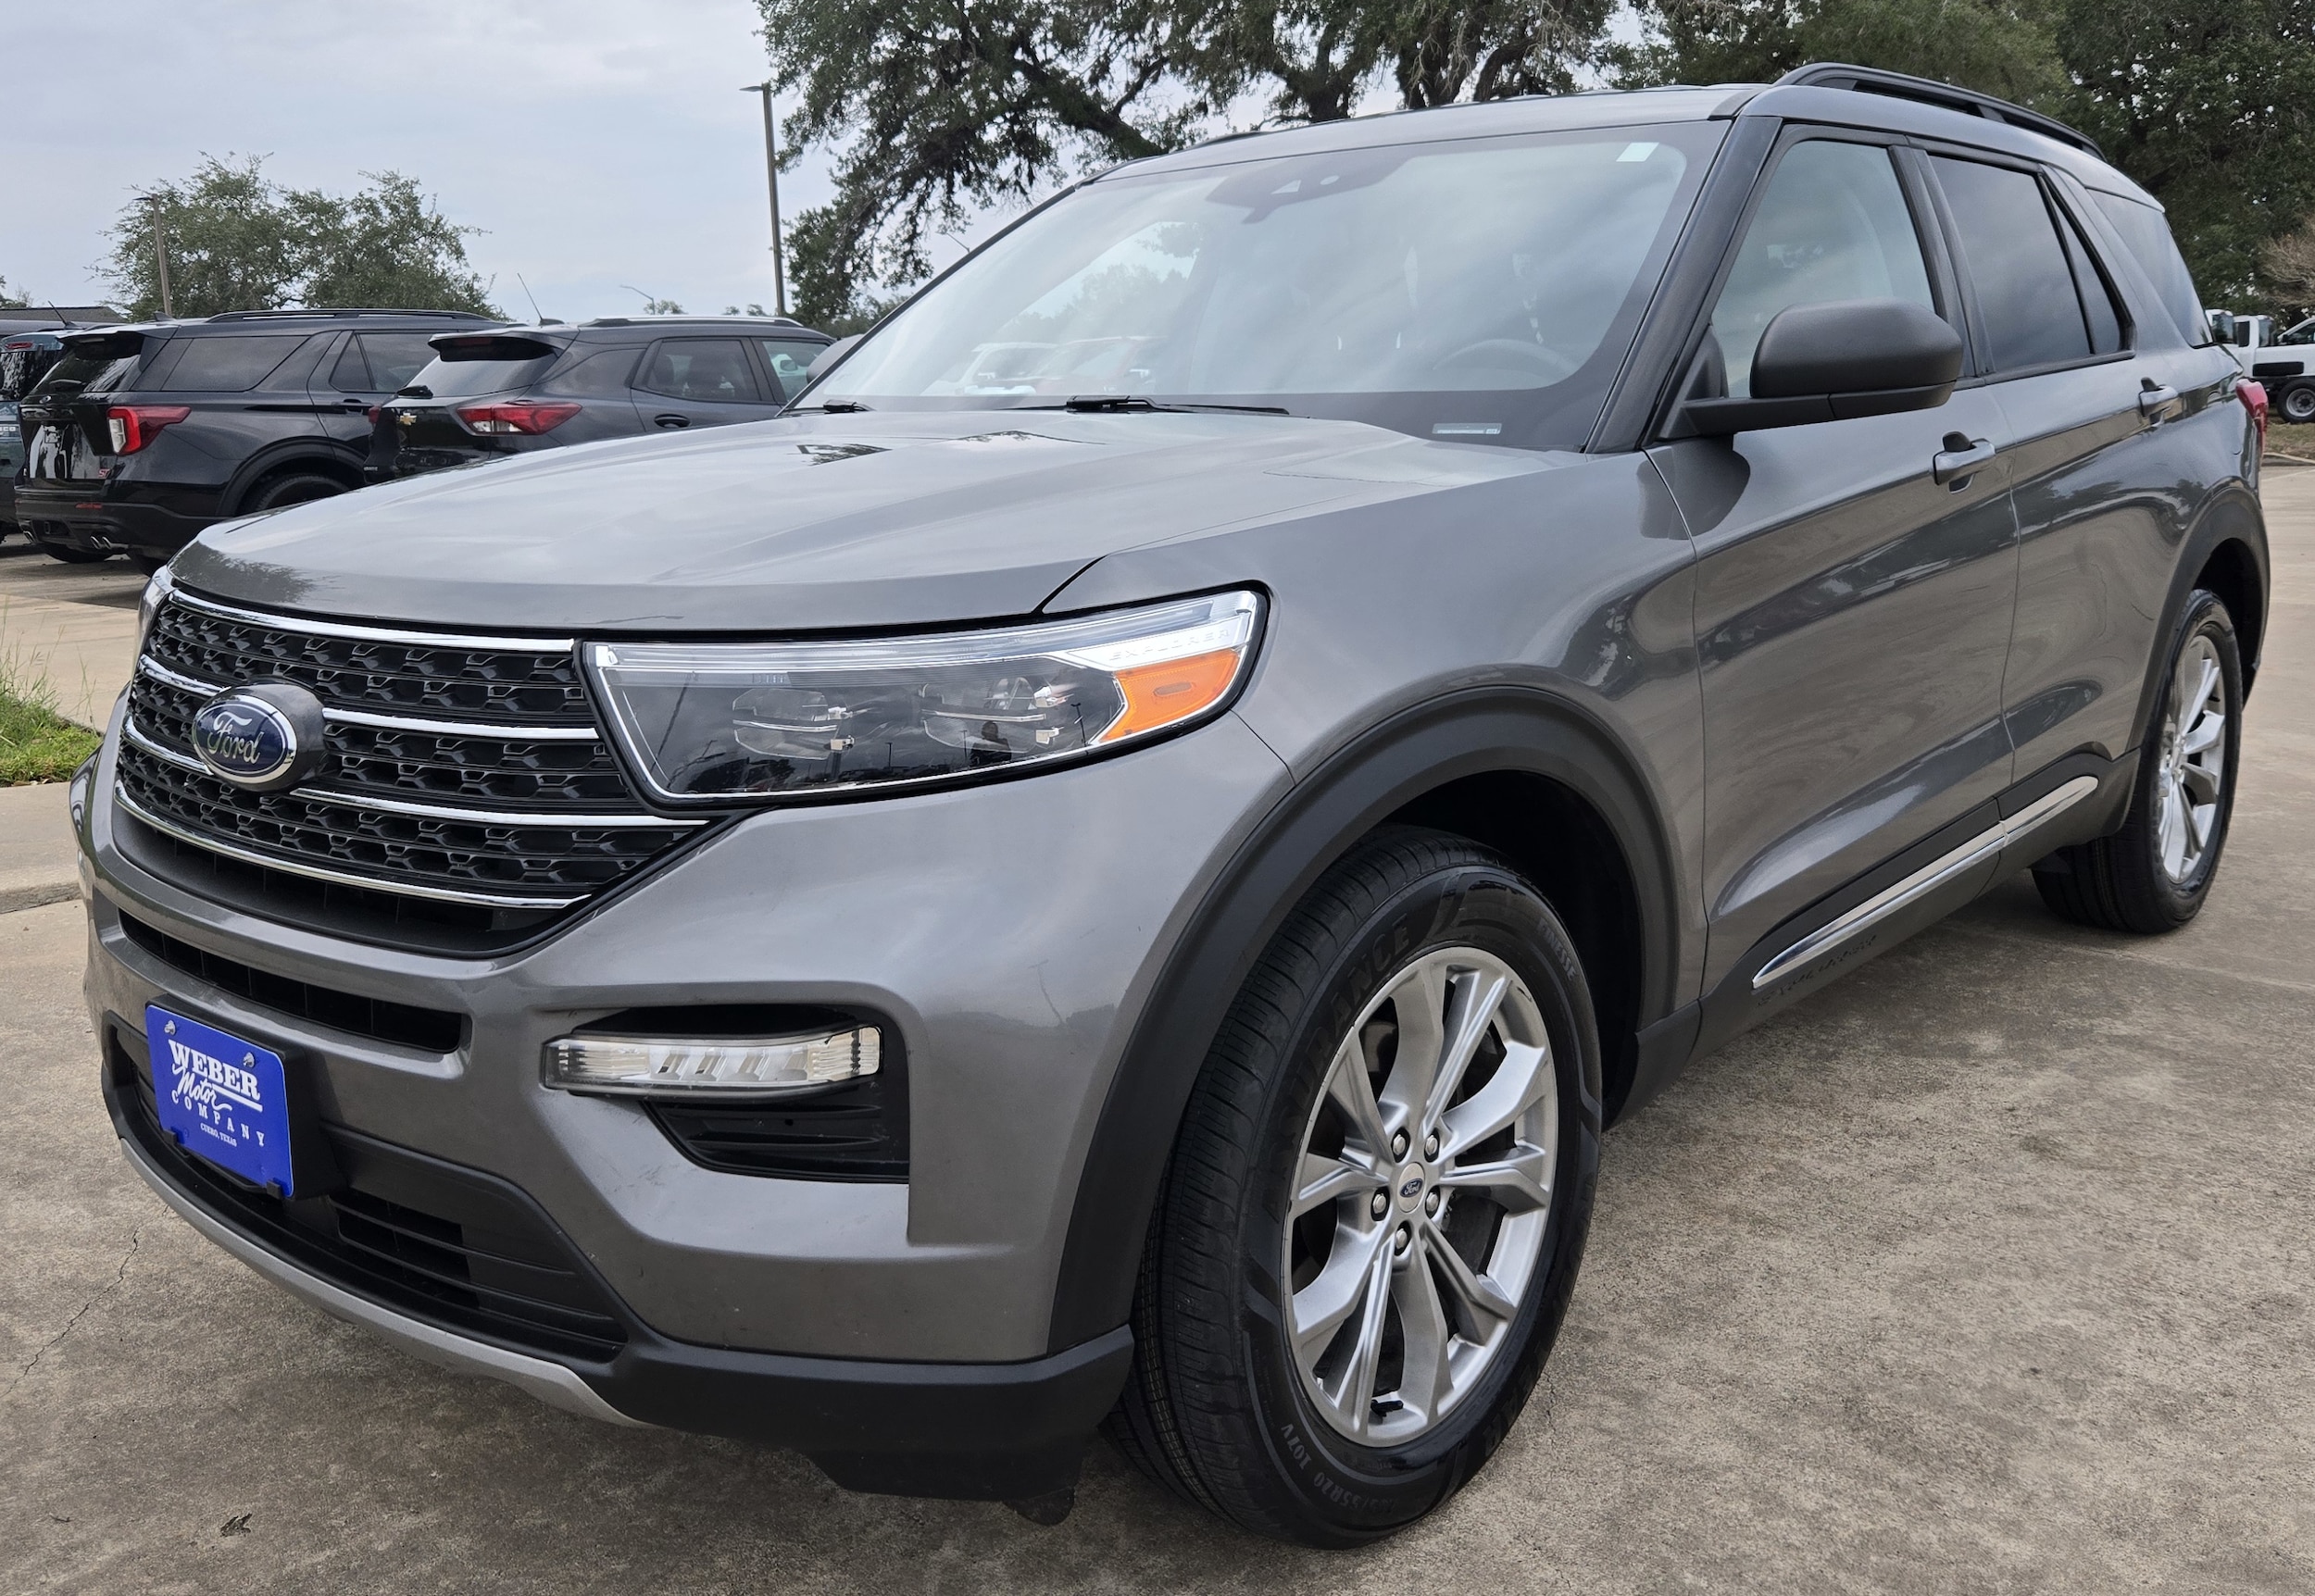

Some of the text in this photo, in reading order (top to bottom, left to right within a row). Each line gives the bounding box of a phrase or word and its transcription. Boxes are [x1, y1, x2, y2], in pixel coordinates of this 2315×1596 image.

[98, 468, 110, 478] ST
[207, 711, 265, 764] Ford
[169, 1040, 260, 1101] WEBER
[173, 1064, 232, 1111] Motor
[171, 1090, 265, 1147] COMPANY
[219, 1132, 237, 1147] TEXAS
[1404, 1181, 1420, 1195] Ford
[1281, 1424, 1312, 1470] 107V
